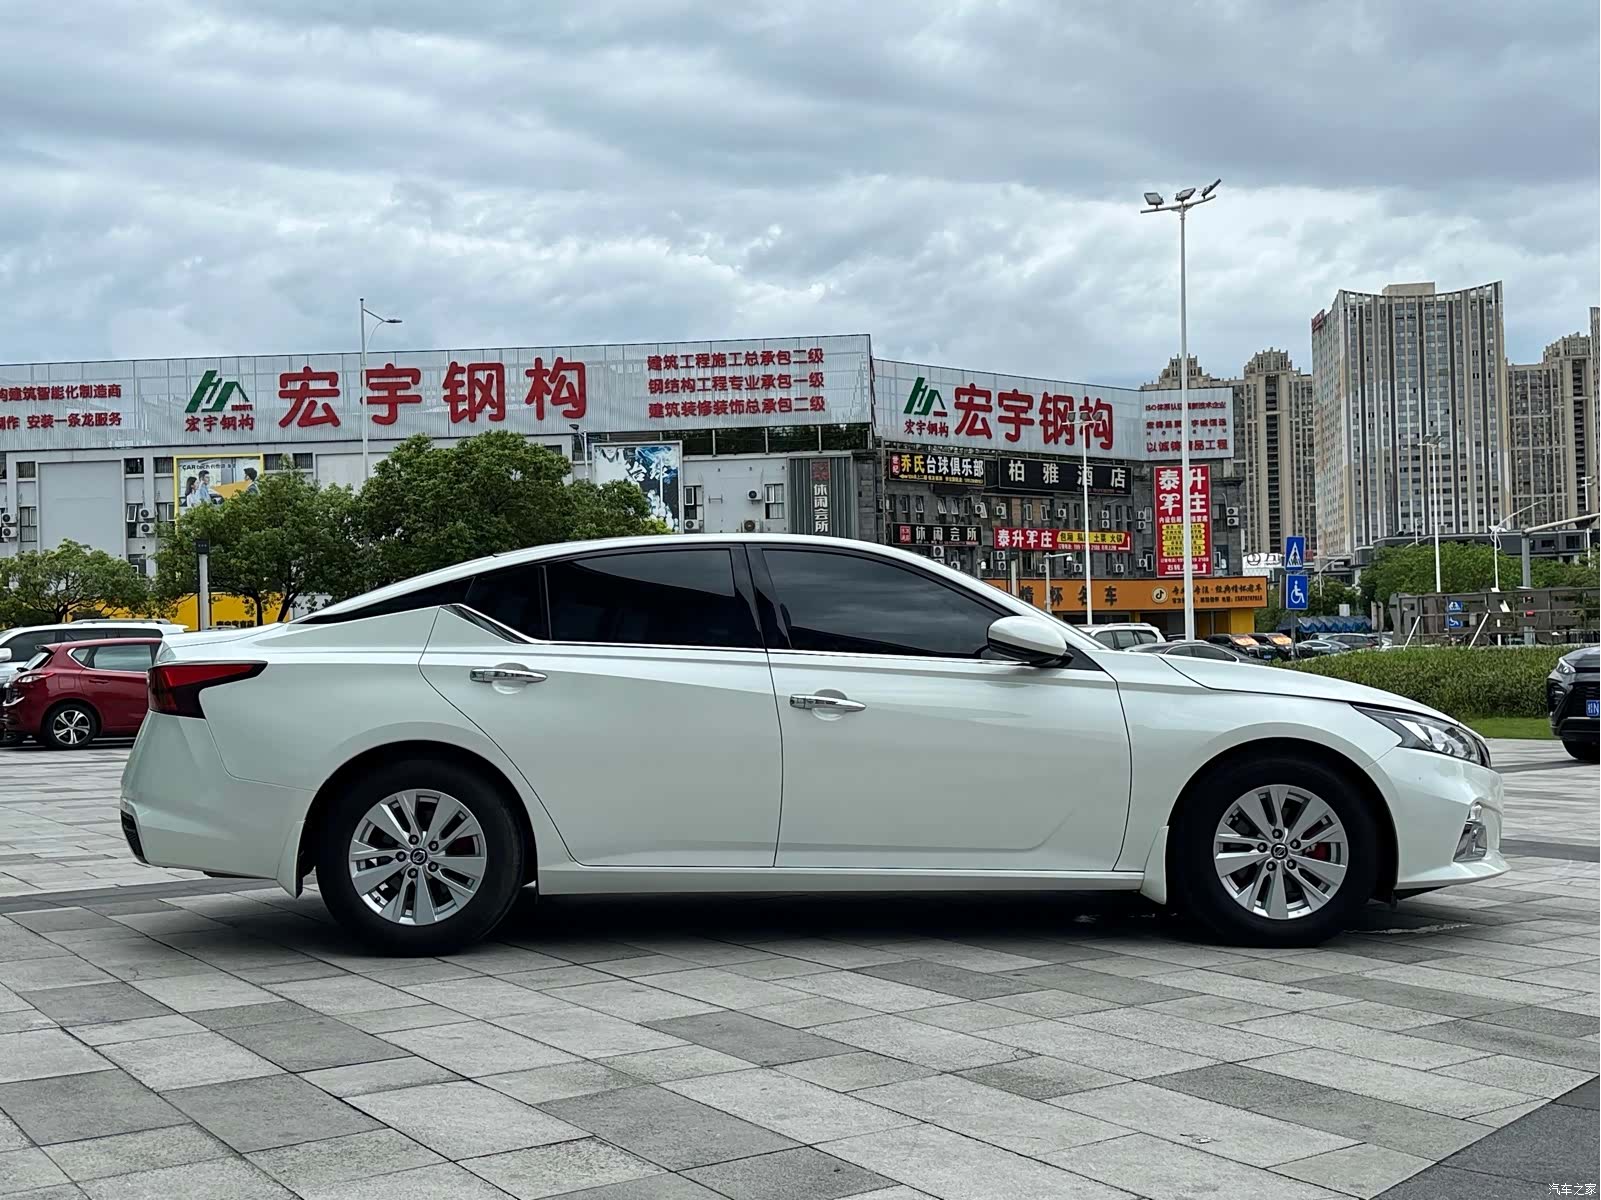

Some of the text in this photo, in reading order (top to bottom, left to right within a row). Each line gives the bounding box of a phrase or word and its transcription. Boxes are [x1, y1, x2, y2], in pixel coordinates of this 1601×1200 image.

[647, 348, 824, 371] 建筑工程施工总承包二级
[279, 357, 586, 428] 宏宇钢构
[648, 371, 824, 394] 钢结构工程专业承包一级
[648, 396, 826, 418] 建筑装修装饰总承包二级
[954, 383, 1113, 450] 宏宇钢构
[27, 412, 122, 429] 安装一条龙服务
[185, 414, 255, 432] 宏宇钢构
[904, 420, 949, 438] 宏宇钢构
[901, 454, 984, 477] 乔氏台球俱乐部
[1008, 460, 1126, 488] 柏雅酒店
[814, 484, 829, 532] 休闲会所
[915, 526, 977, 541] 休闲会所
